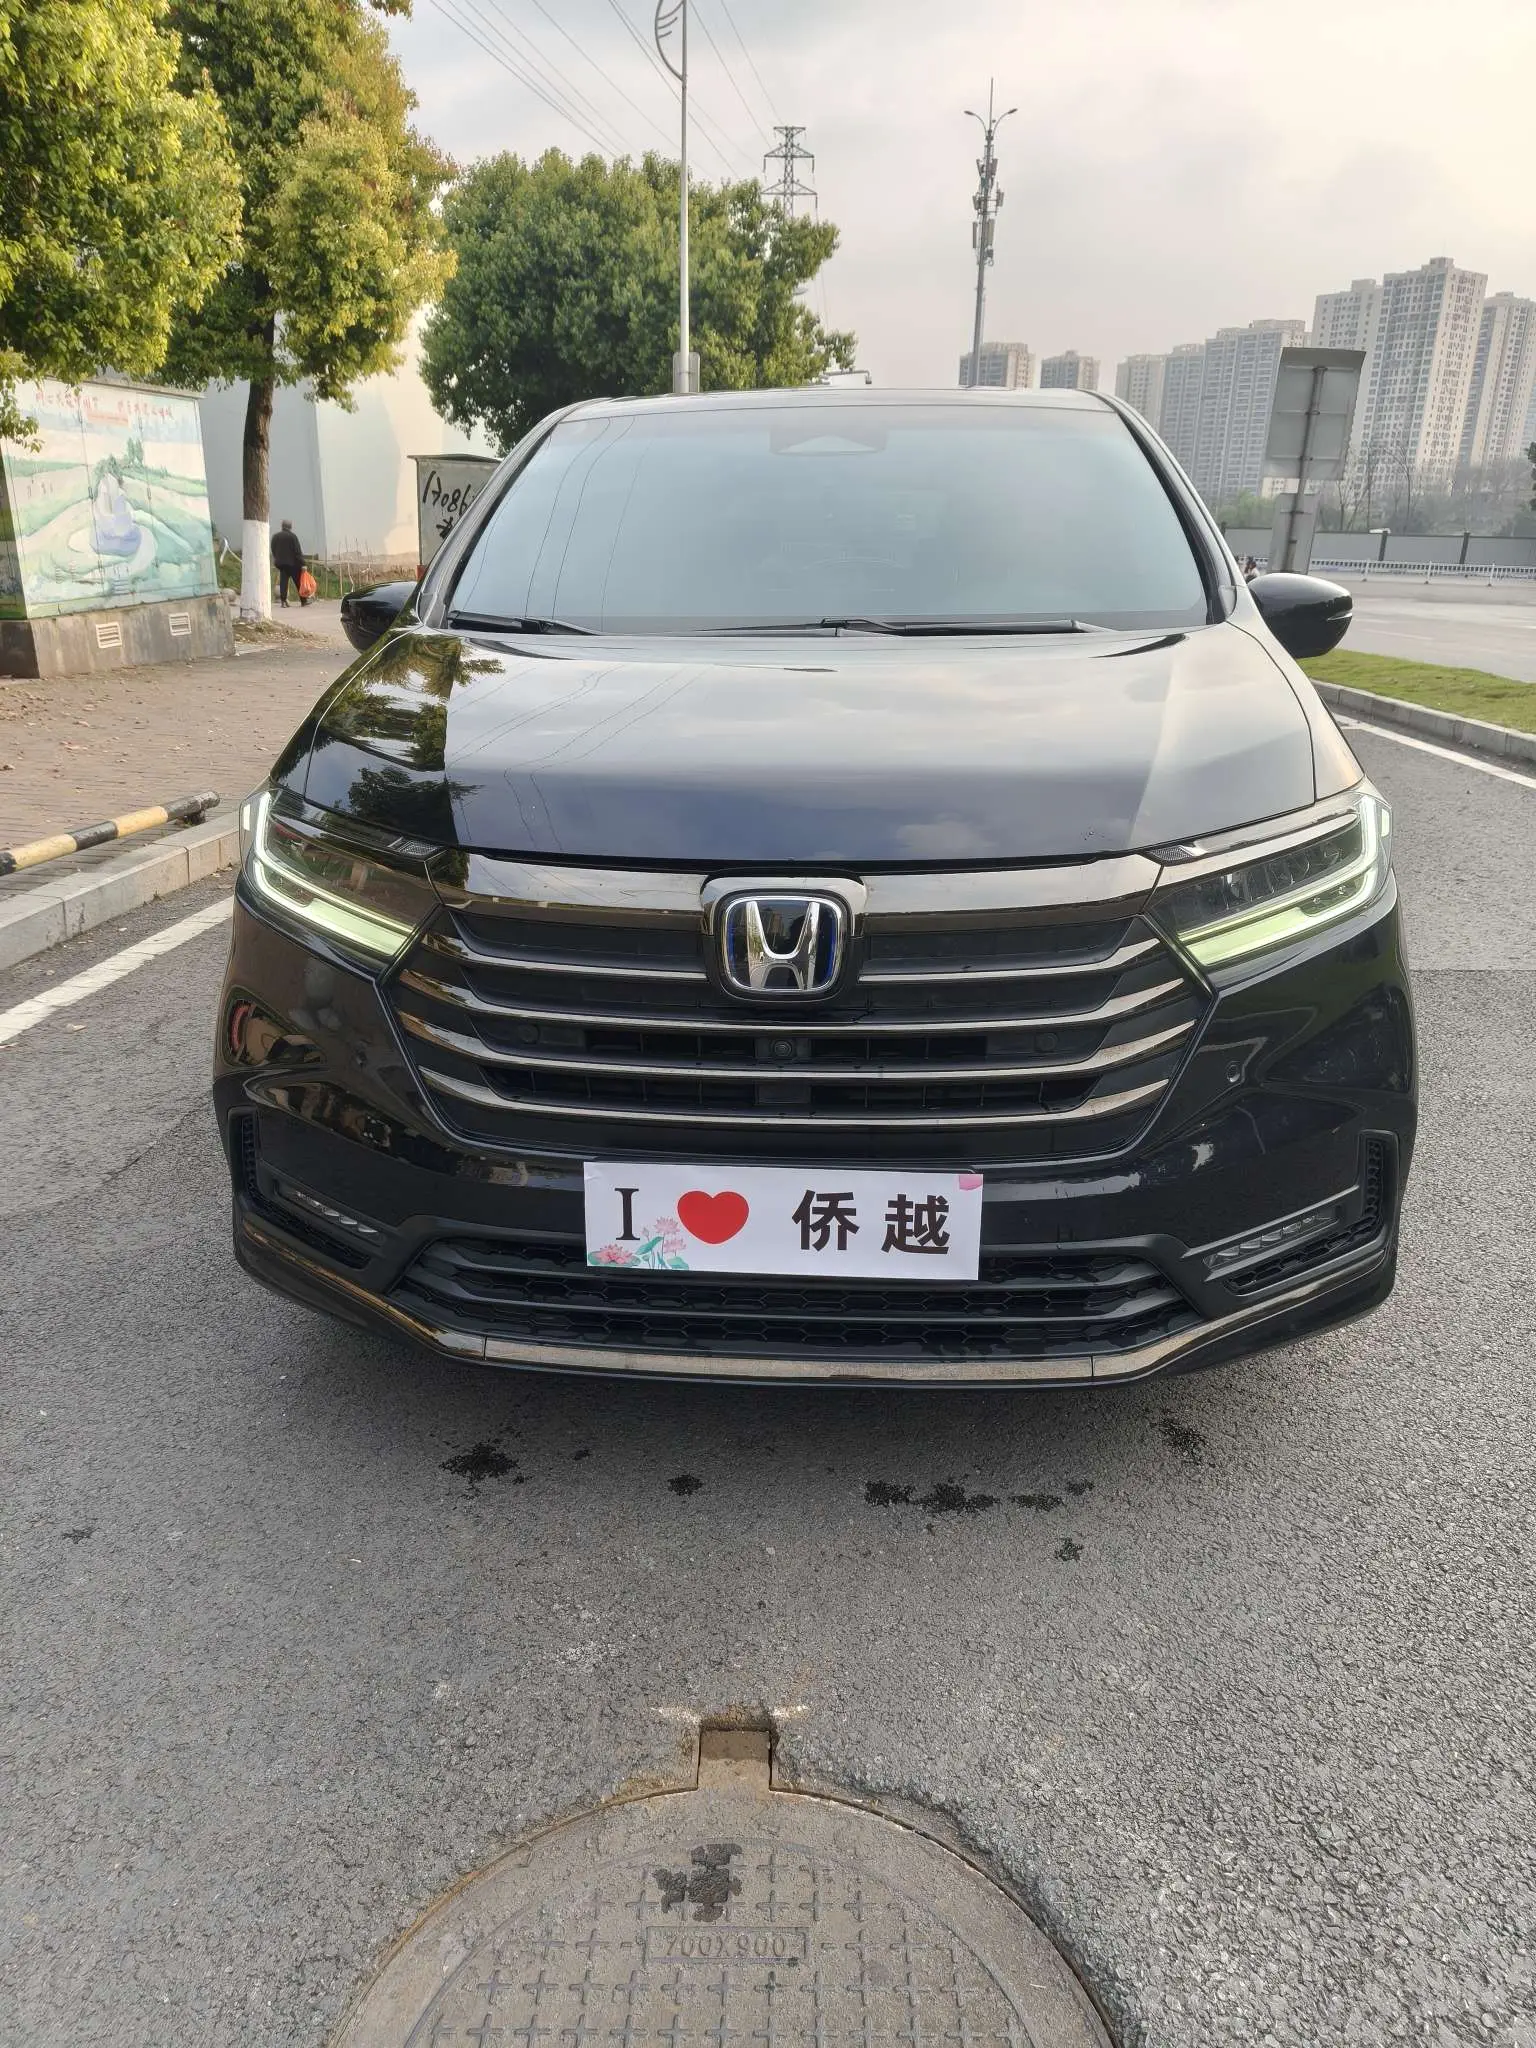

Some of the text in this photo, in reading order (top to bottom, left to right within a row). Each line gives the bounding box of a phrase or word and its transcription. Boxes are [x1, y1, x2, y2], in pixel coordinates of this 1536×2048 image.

[746, 901, 820, 988] H
[614, 1187, 950, 1254] I 侨越
